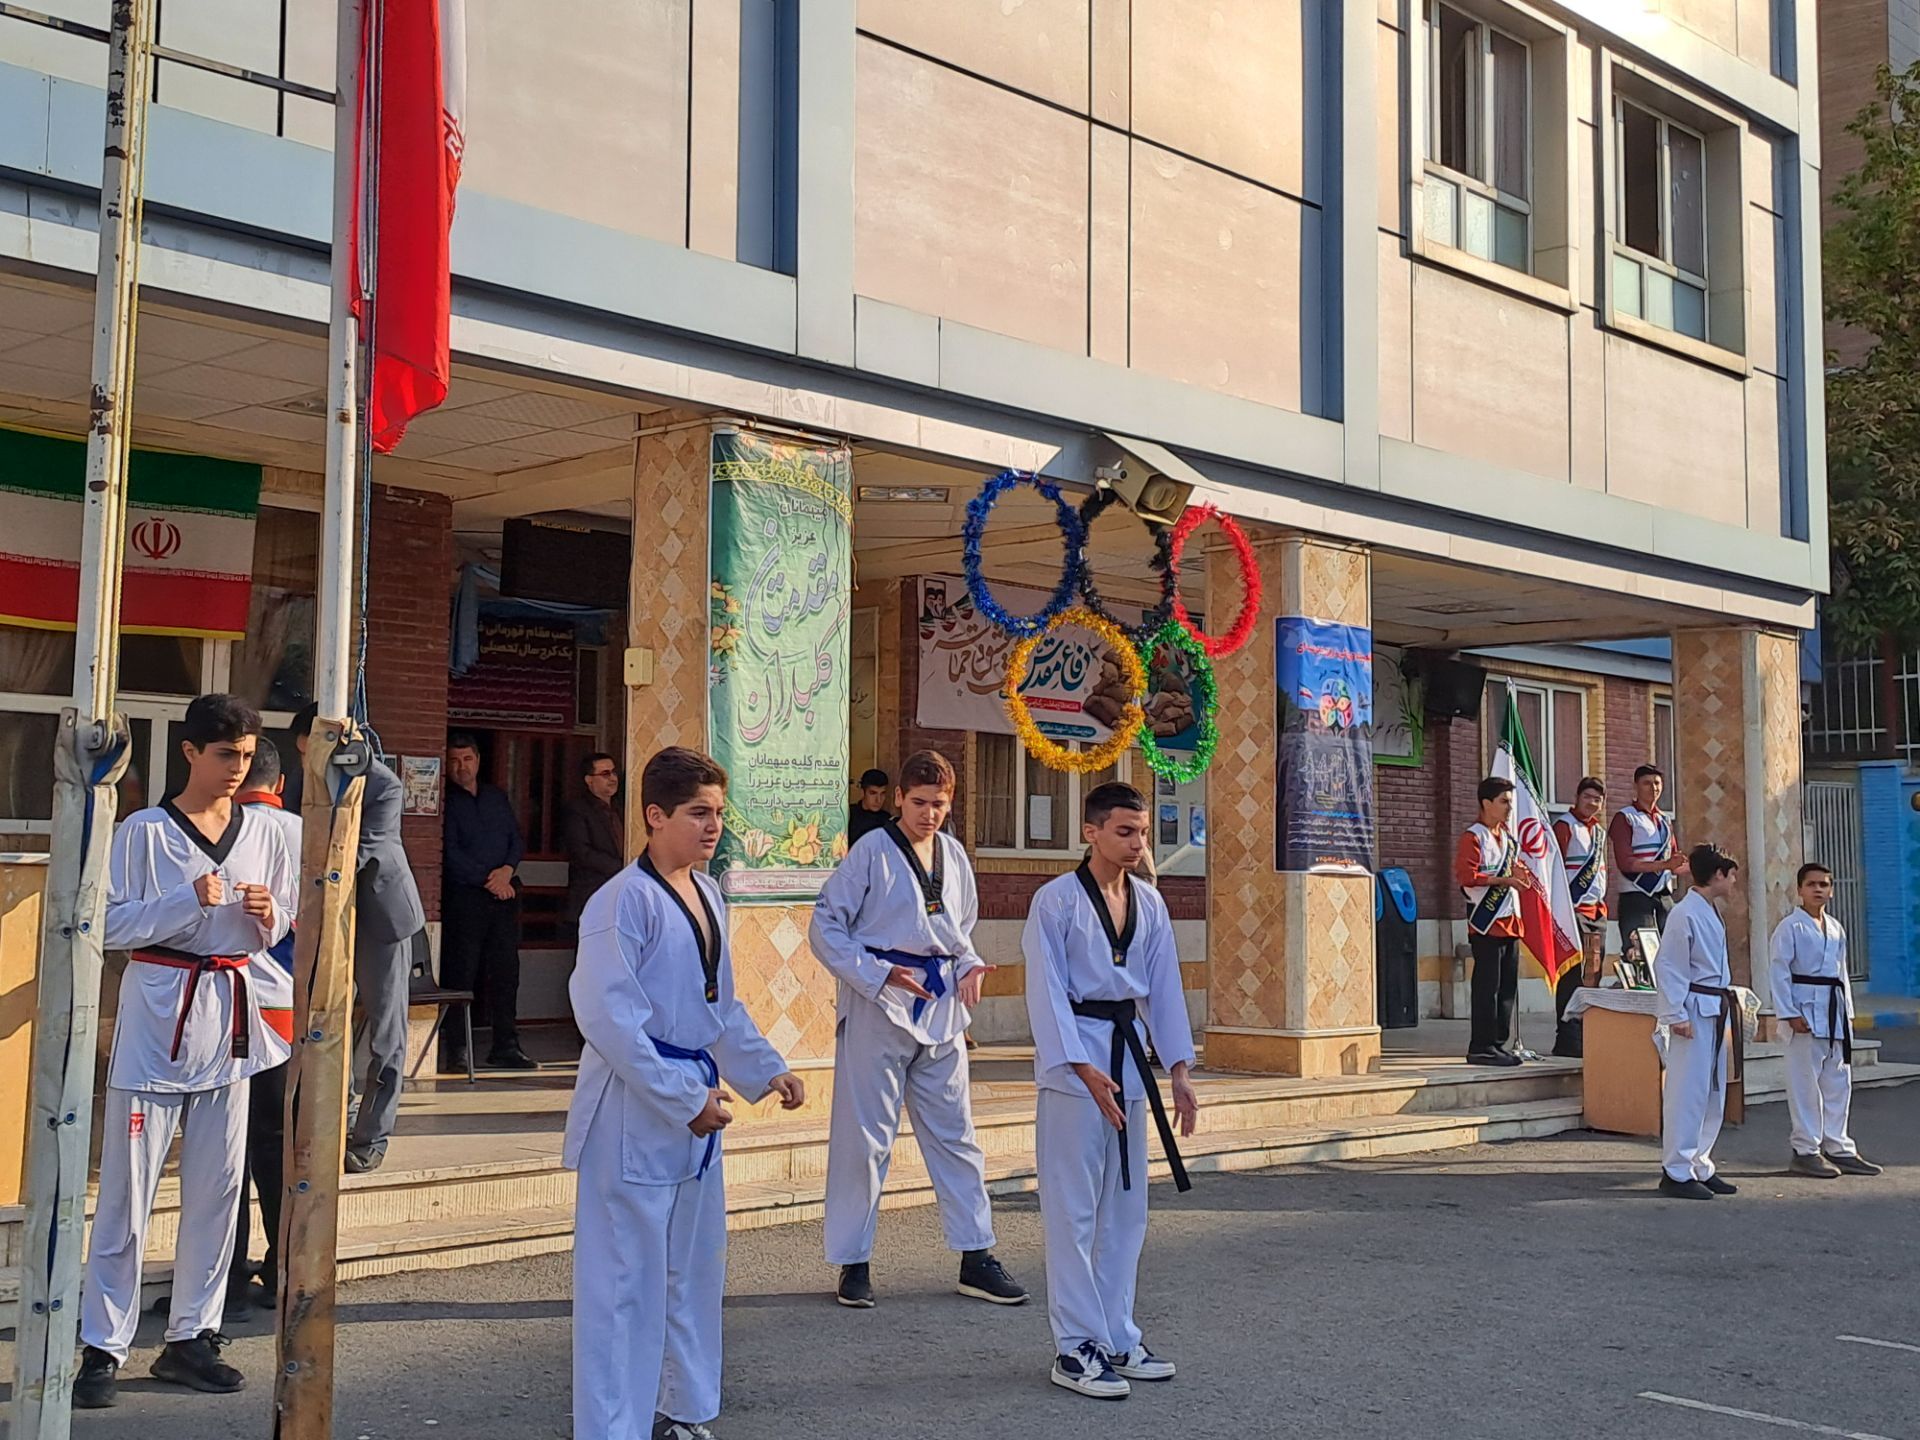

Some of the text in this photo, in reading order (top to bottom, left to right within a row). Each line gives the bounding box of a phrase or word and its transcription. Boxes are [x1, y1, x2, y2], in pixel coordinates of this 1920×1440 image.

[790, 527, 817, 546] عزیز
[526, 625, 551, 639] مقام
[480, 640, 518, 655] تحصیلی
[519, 643, 539, 657] سال
[540, 645, 559, 660] کرج
[1008, 638, 1063, 695] مقدس
[1061, 642, 1090, 692] دفاع
[748, 752, 840, 769] مقدم کلیه میهمانان
[748, 772, 757, 788] را
[757, 774, 781, 788] عزیز
[782, 776, 834, 789] مدعوین
[804, 790, 840, 808] گرامی
